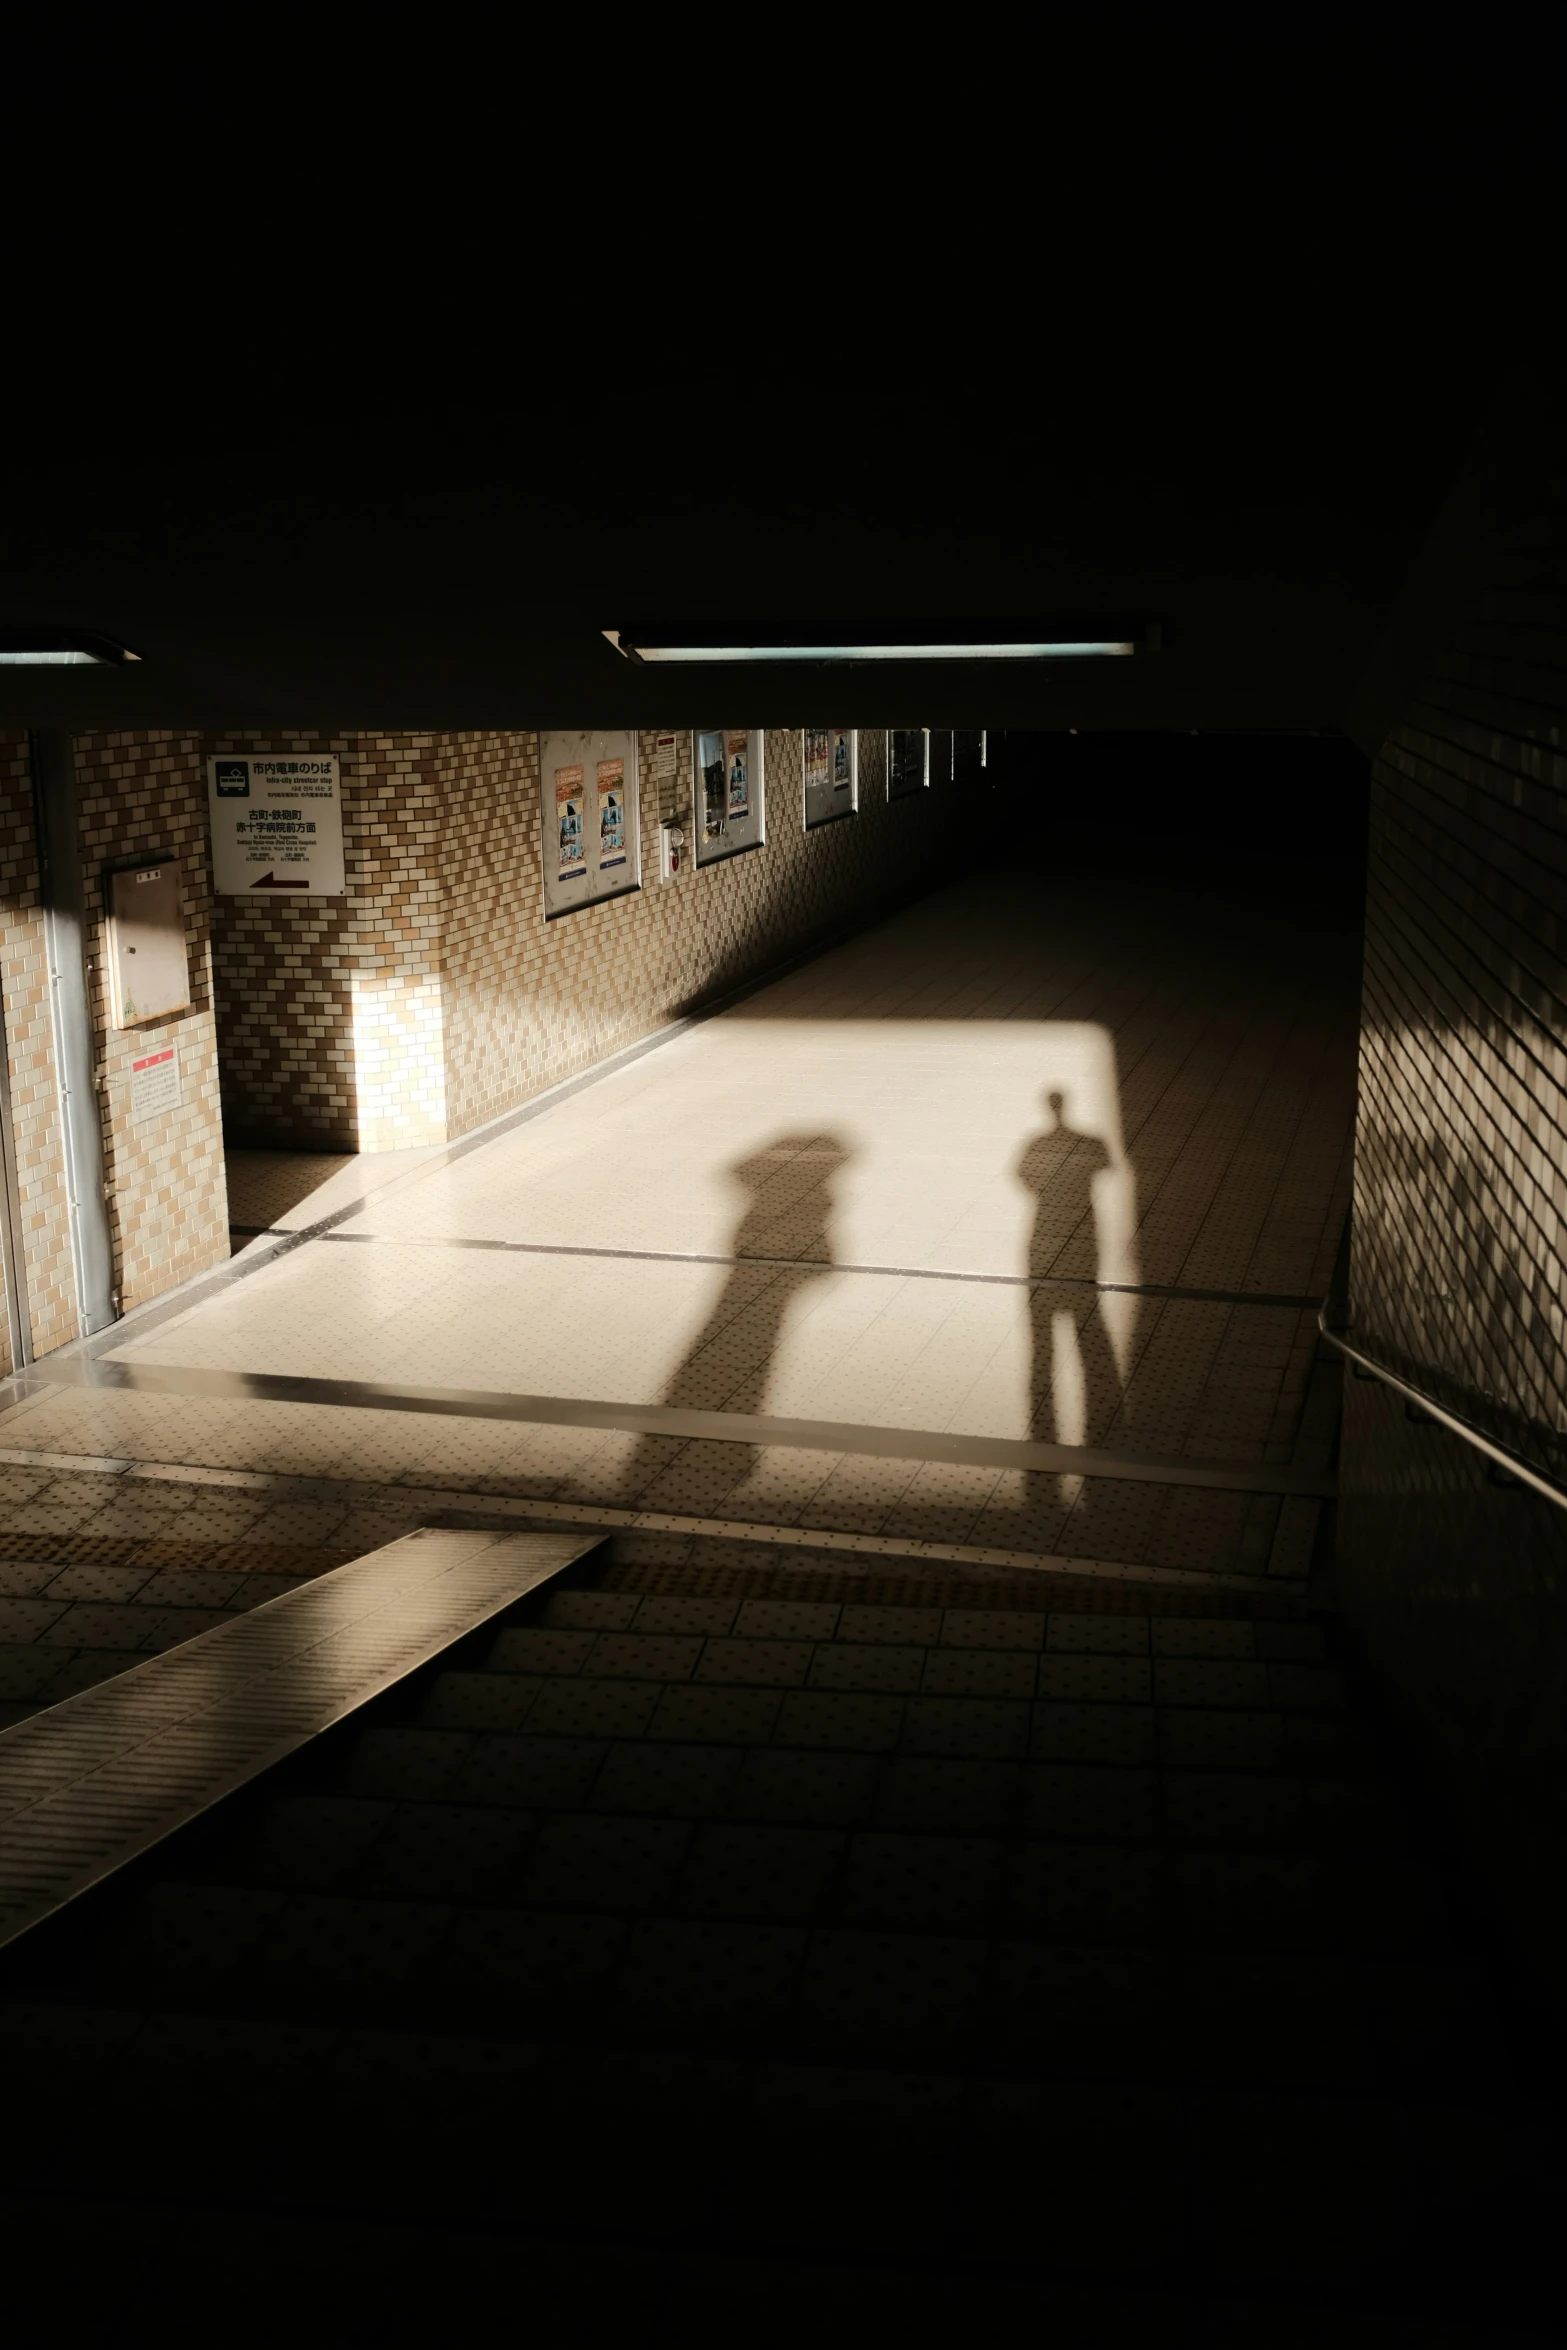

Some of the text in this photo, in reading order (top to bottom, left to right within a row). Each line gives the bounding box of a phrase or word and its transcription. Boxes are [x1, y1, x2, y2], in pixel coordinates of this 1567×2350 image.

[253, 762, 331, 774] 市内電車のりば
[266, 777, 292, 785] Intra-city
[320, 777, 333, 785] stop
[236, 822, 316, 833] 赤十字病院前方面
